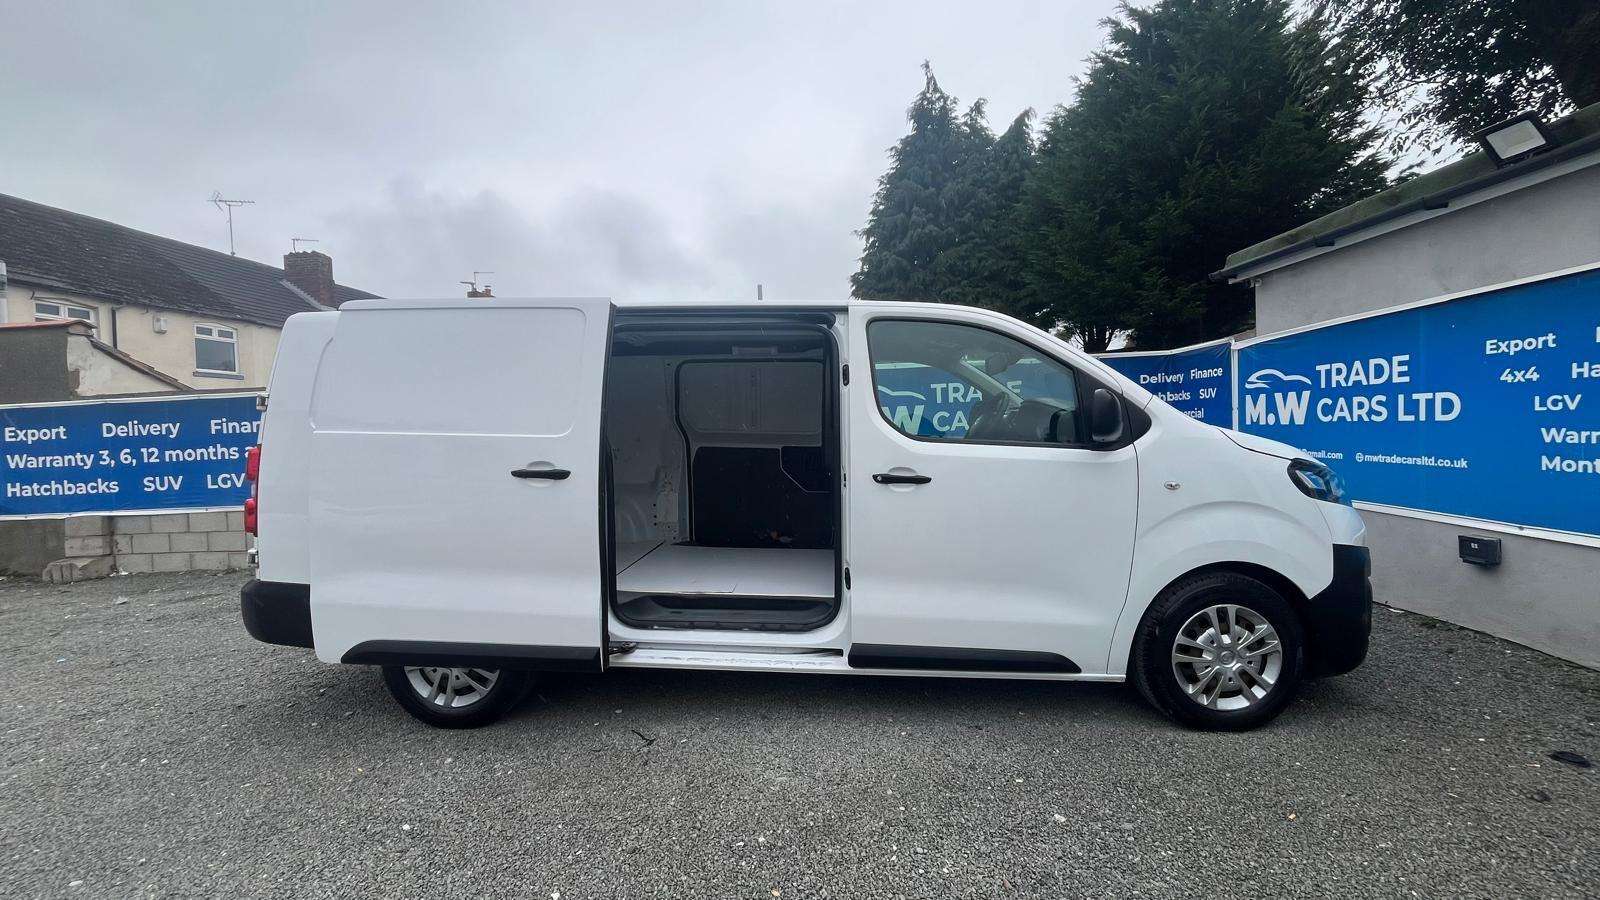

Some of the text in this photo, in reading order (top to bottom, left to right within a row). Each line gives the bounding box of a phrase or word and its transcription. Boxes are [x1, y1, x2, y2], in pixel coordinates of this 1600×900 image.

[1485, 332, 1556, 356] Export
[1140, 367, 1223, 384] Delivery Finance
[1316, 354, 1410, 389] TRADE
[1500, 365, 1539, 383] 4x4
[930, 380, 1023, 404] TRAE
[1199, 387, 1217, 399] SUV
[1534, 394, 1581, 412] LGV
[1245, 390, 1311, 426] M.W
[1316, 391, 1462, 422] CARS LTD
[4, 425, 67, 444] Export
[102, 420, 180, 438] Delivery
[6, 451, 94, 470] Warranty
[99, 450, 115, 468] 3,
[119, 448, 136, 466] 6,
[140, 447, 160, 464] 12
[165, 444, 240, 462] months
[6, 472, 246, 498] Hatchbacks SUV LGV
